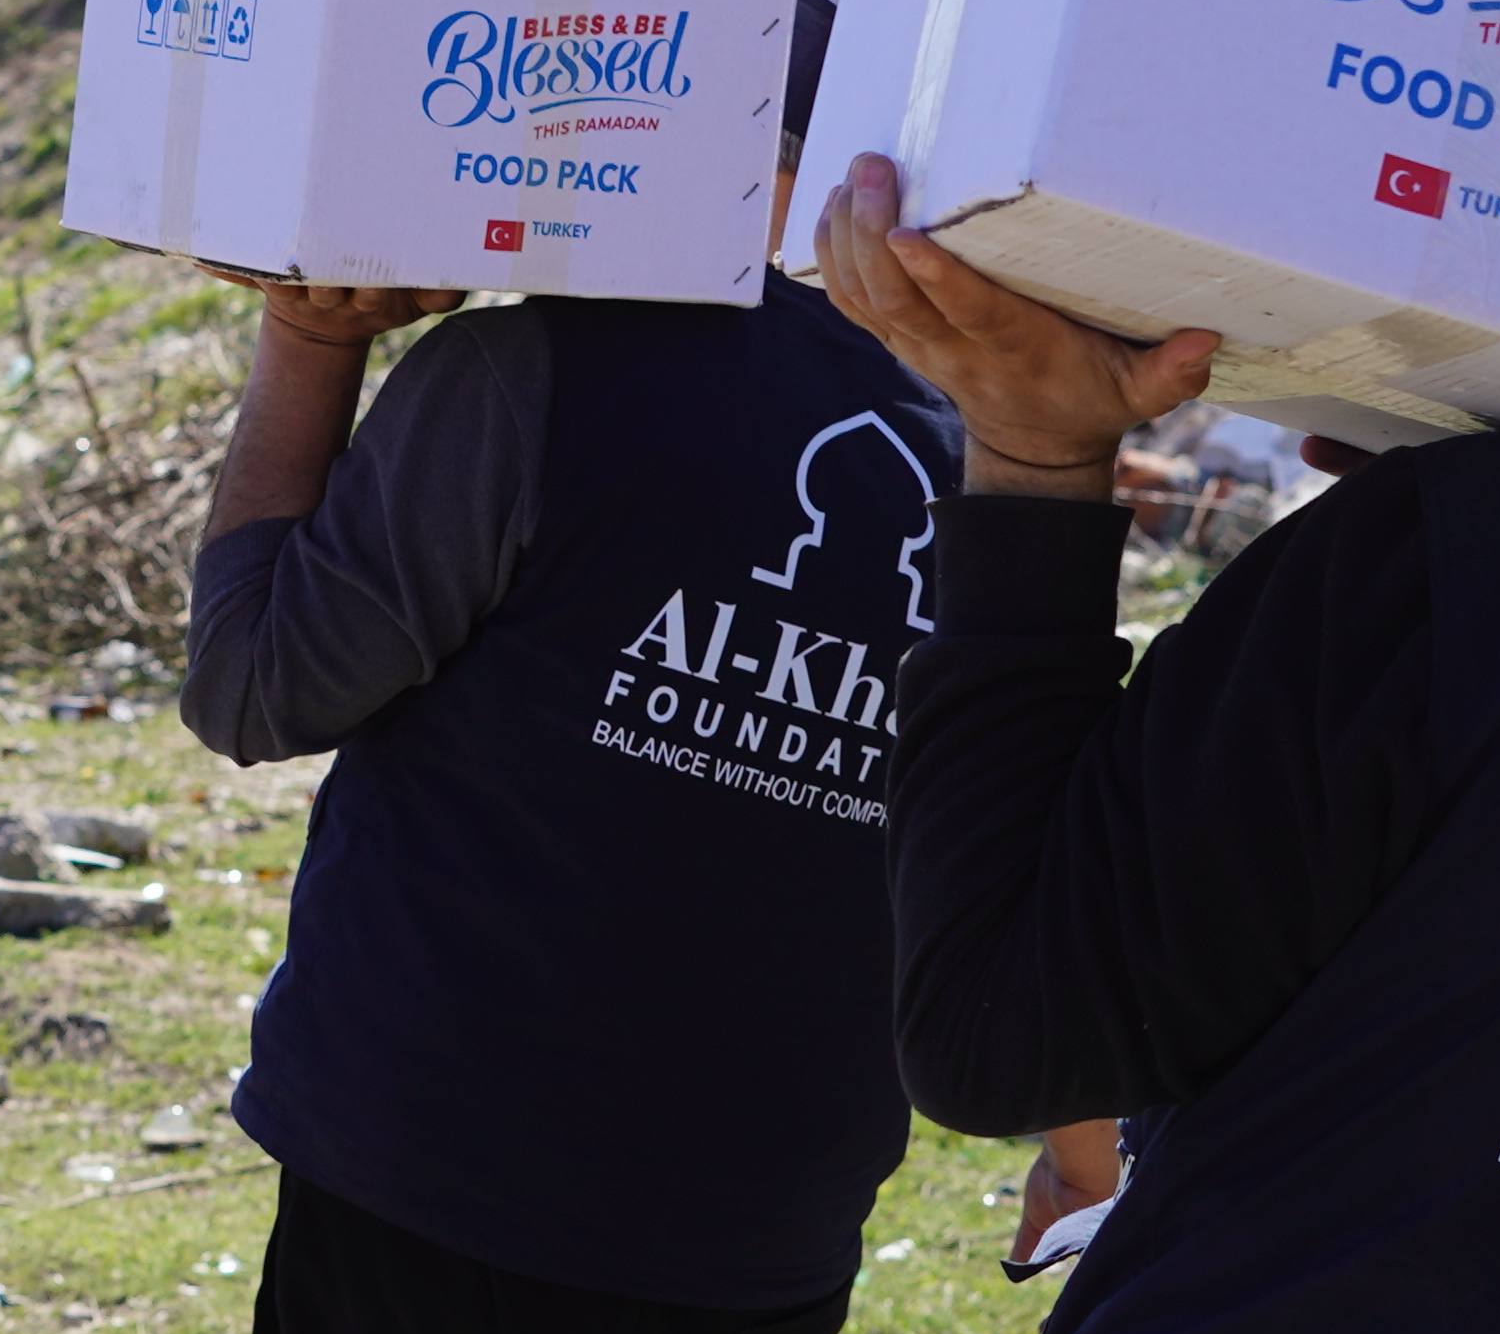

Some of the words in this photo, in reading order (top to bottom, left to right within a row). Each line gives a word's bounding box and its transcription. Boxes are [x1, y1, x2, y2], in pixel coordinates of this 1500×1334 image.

[523, 15, 604, 39] BLESS
[612, 15, 628, 35] &
[634, 15, 667, 35] BE
[422, 10, 691, 127] Blessed
[1326, 43, 1495, 130] FOOD
[534, 121, 570, 139] THIS
[575, 116, 660, 134] RAMADAN
[454, 152, 548, 186] FOOD
[557, 160, 640, 194] PACK
[532, 221, 592, 238] TURKEY
[604, 669, 882, 783] FOUNDAT
[591, 719, 711, 779] BALANCE
[714, 759, 821, 815] WITHOUT
